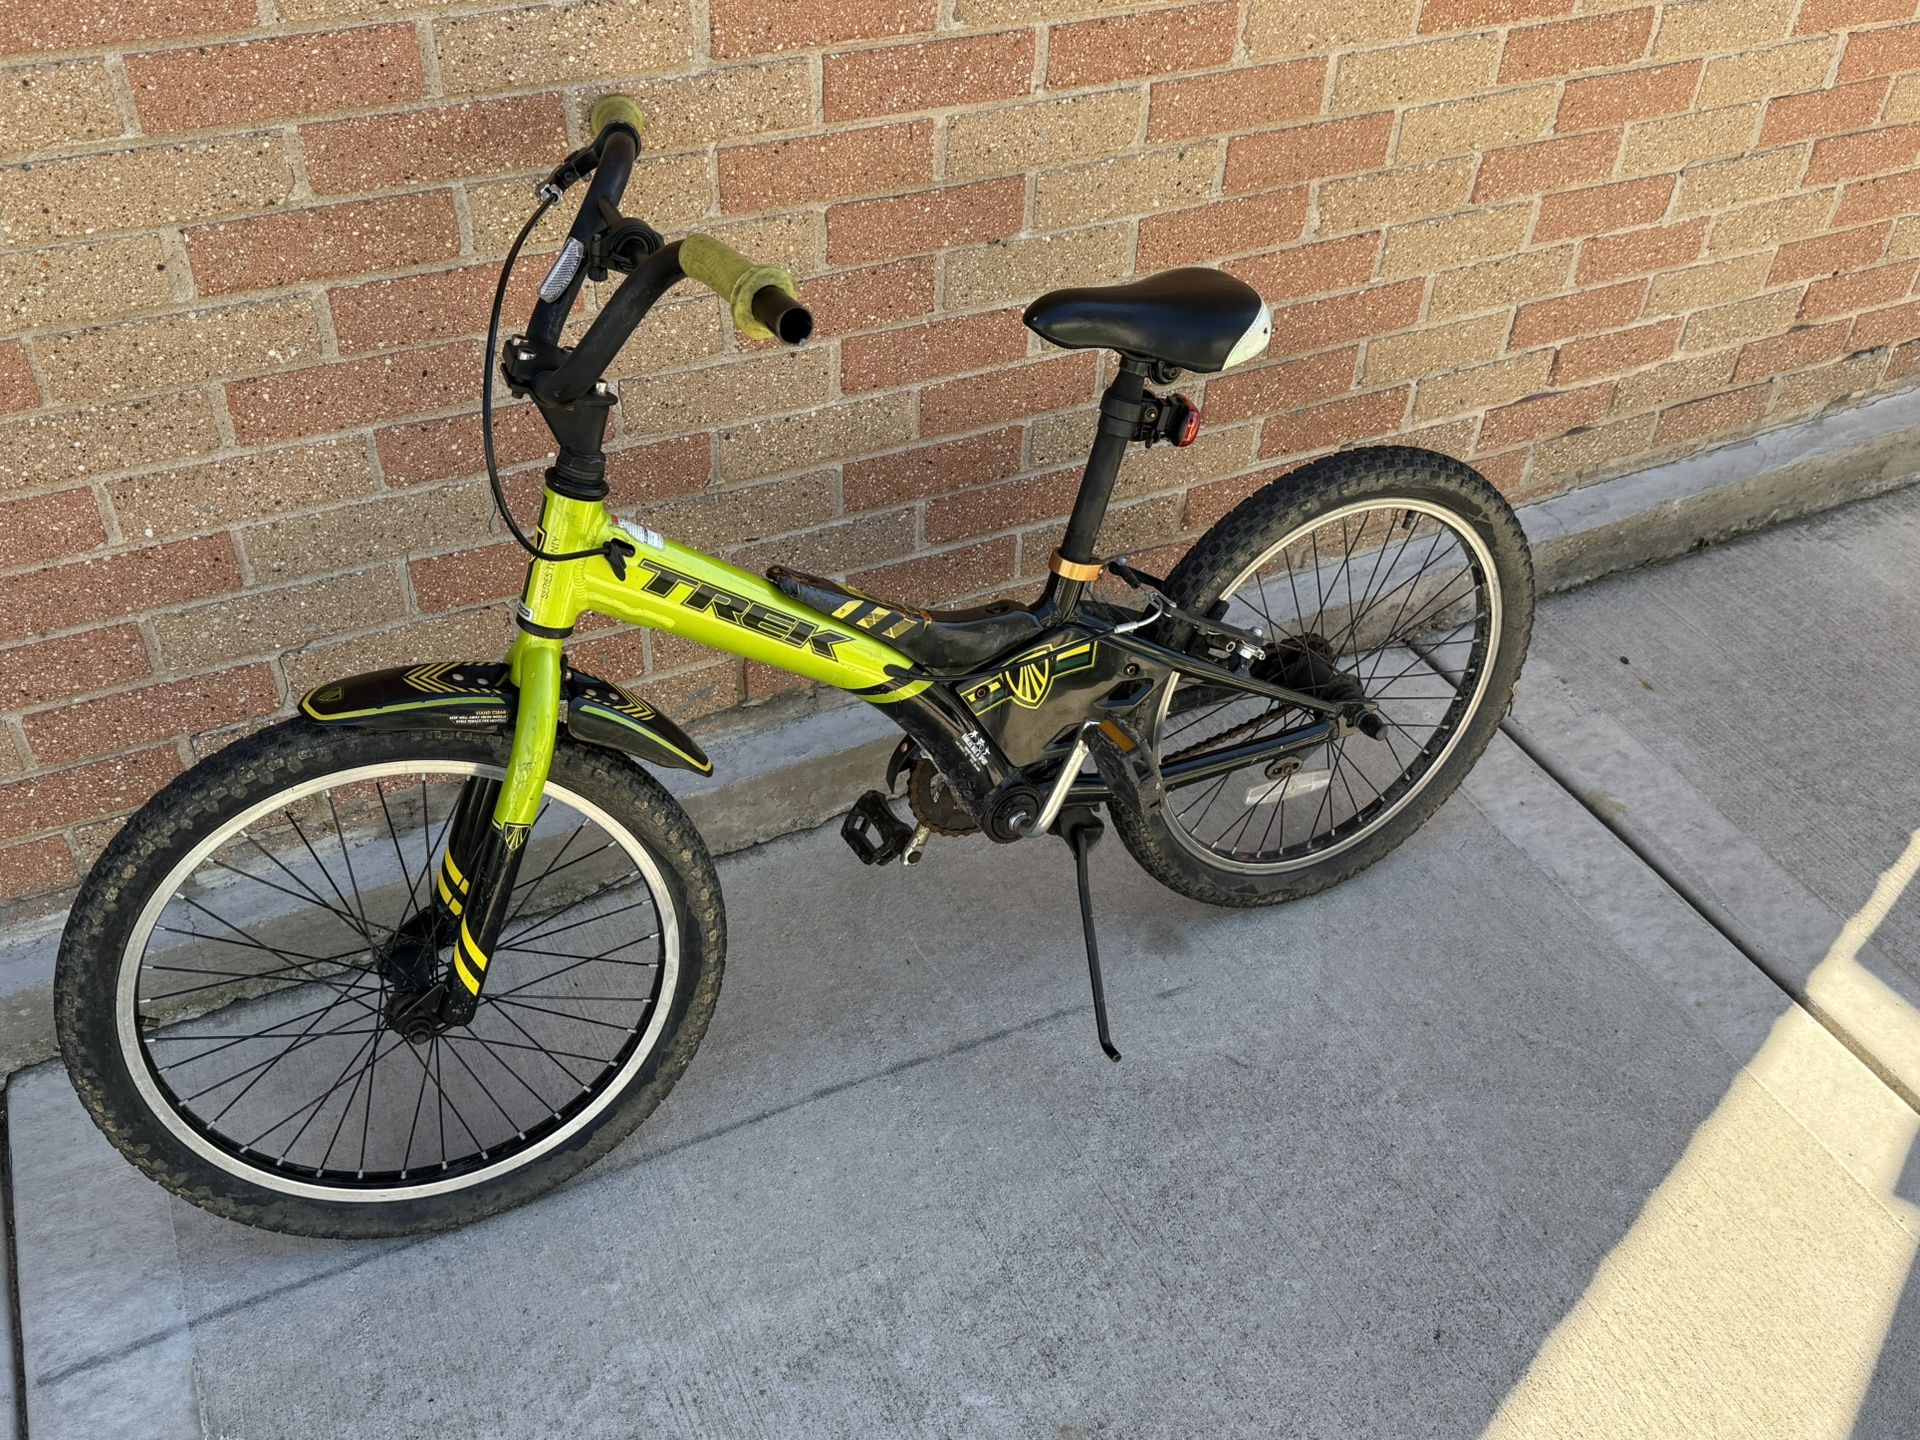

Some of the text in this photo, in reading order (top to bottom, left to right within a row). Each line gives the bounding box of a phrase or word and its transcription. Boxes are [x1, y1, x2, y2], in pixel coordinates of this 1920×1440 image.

[541, 536, 560, 600] SERIES TWNTY
[637, 558, 856, 662] TREK
